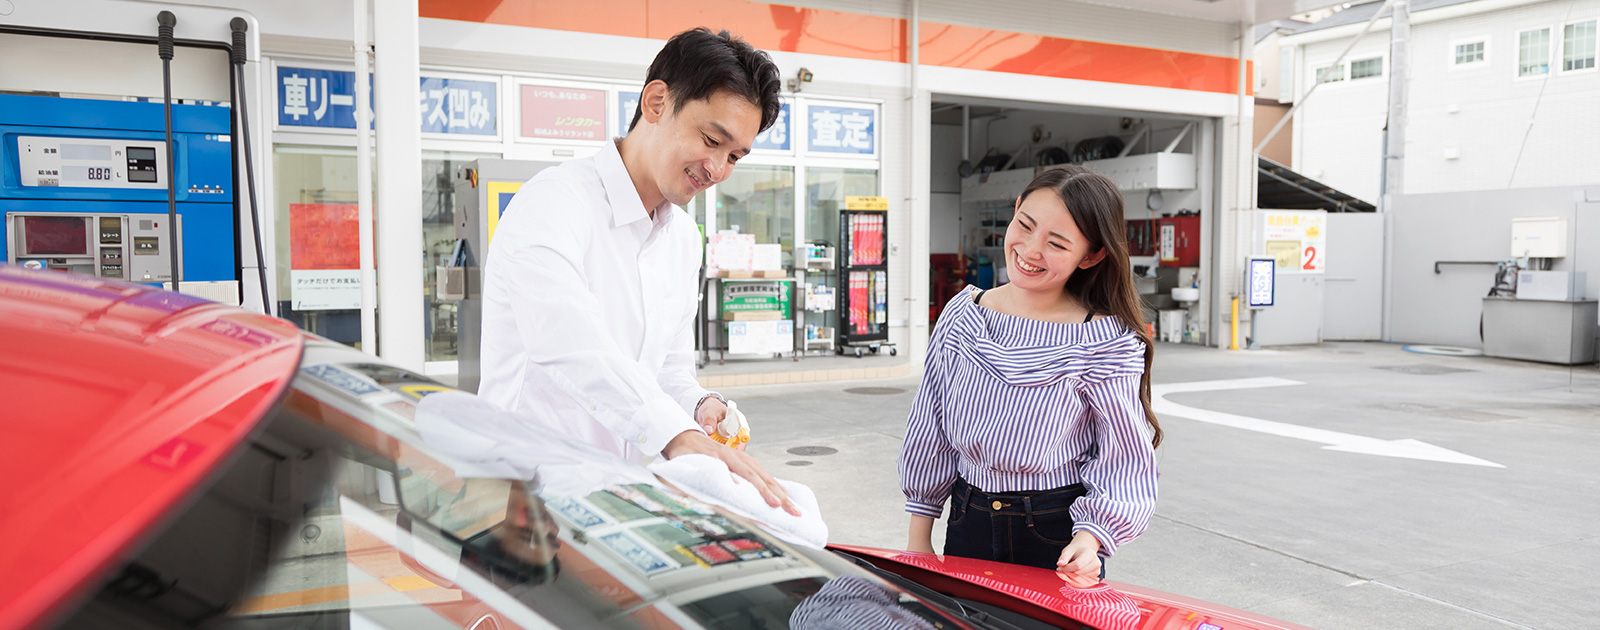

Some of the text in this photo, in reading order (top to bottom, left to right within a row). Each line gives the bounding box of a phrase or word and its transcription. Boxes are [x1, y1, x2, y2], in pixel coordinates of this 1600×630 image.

[554, 116, 602, 127] レンタカー
[812, 110, 870, 149] 査定
[88, 167, 111, 180] 8.80
[1303, 246, 1316, 270] 2
